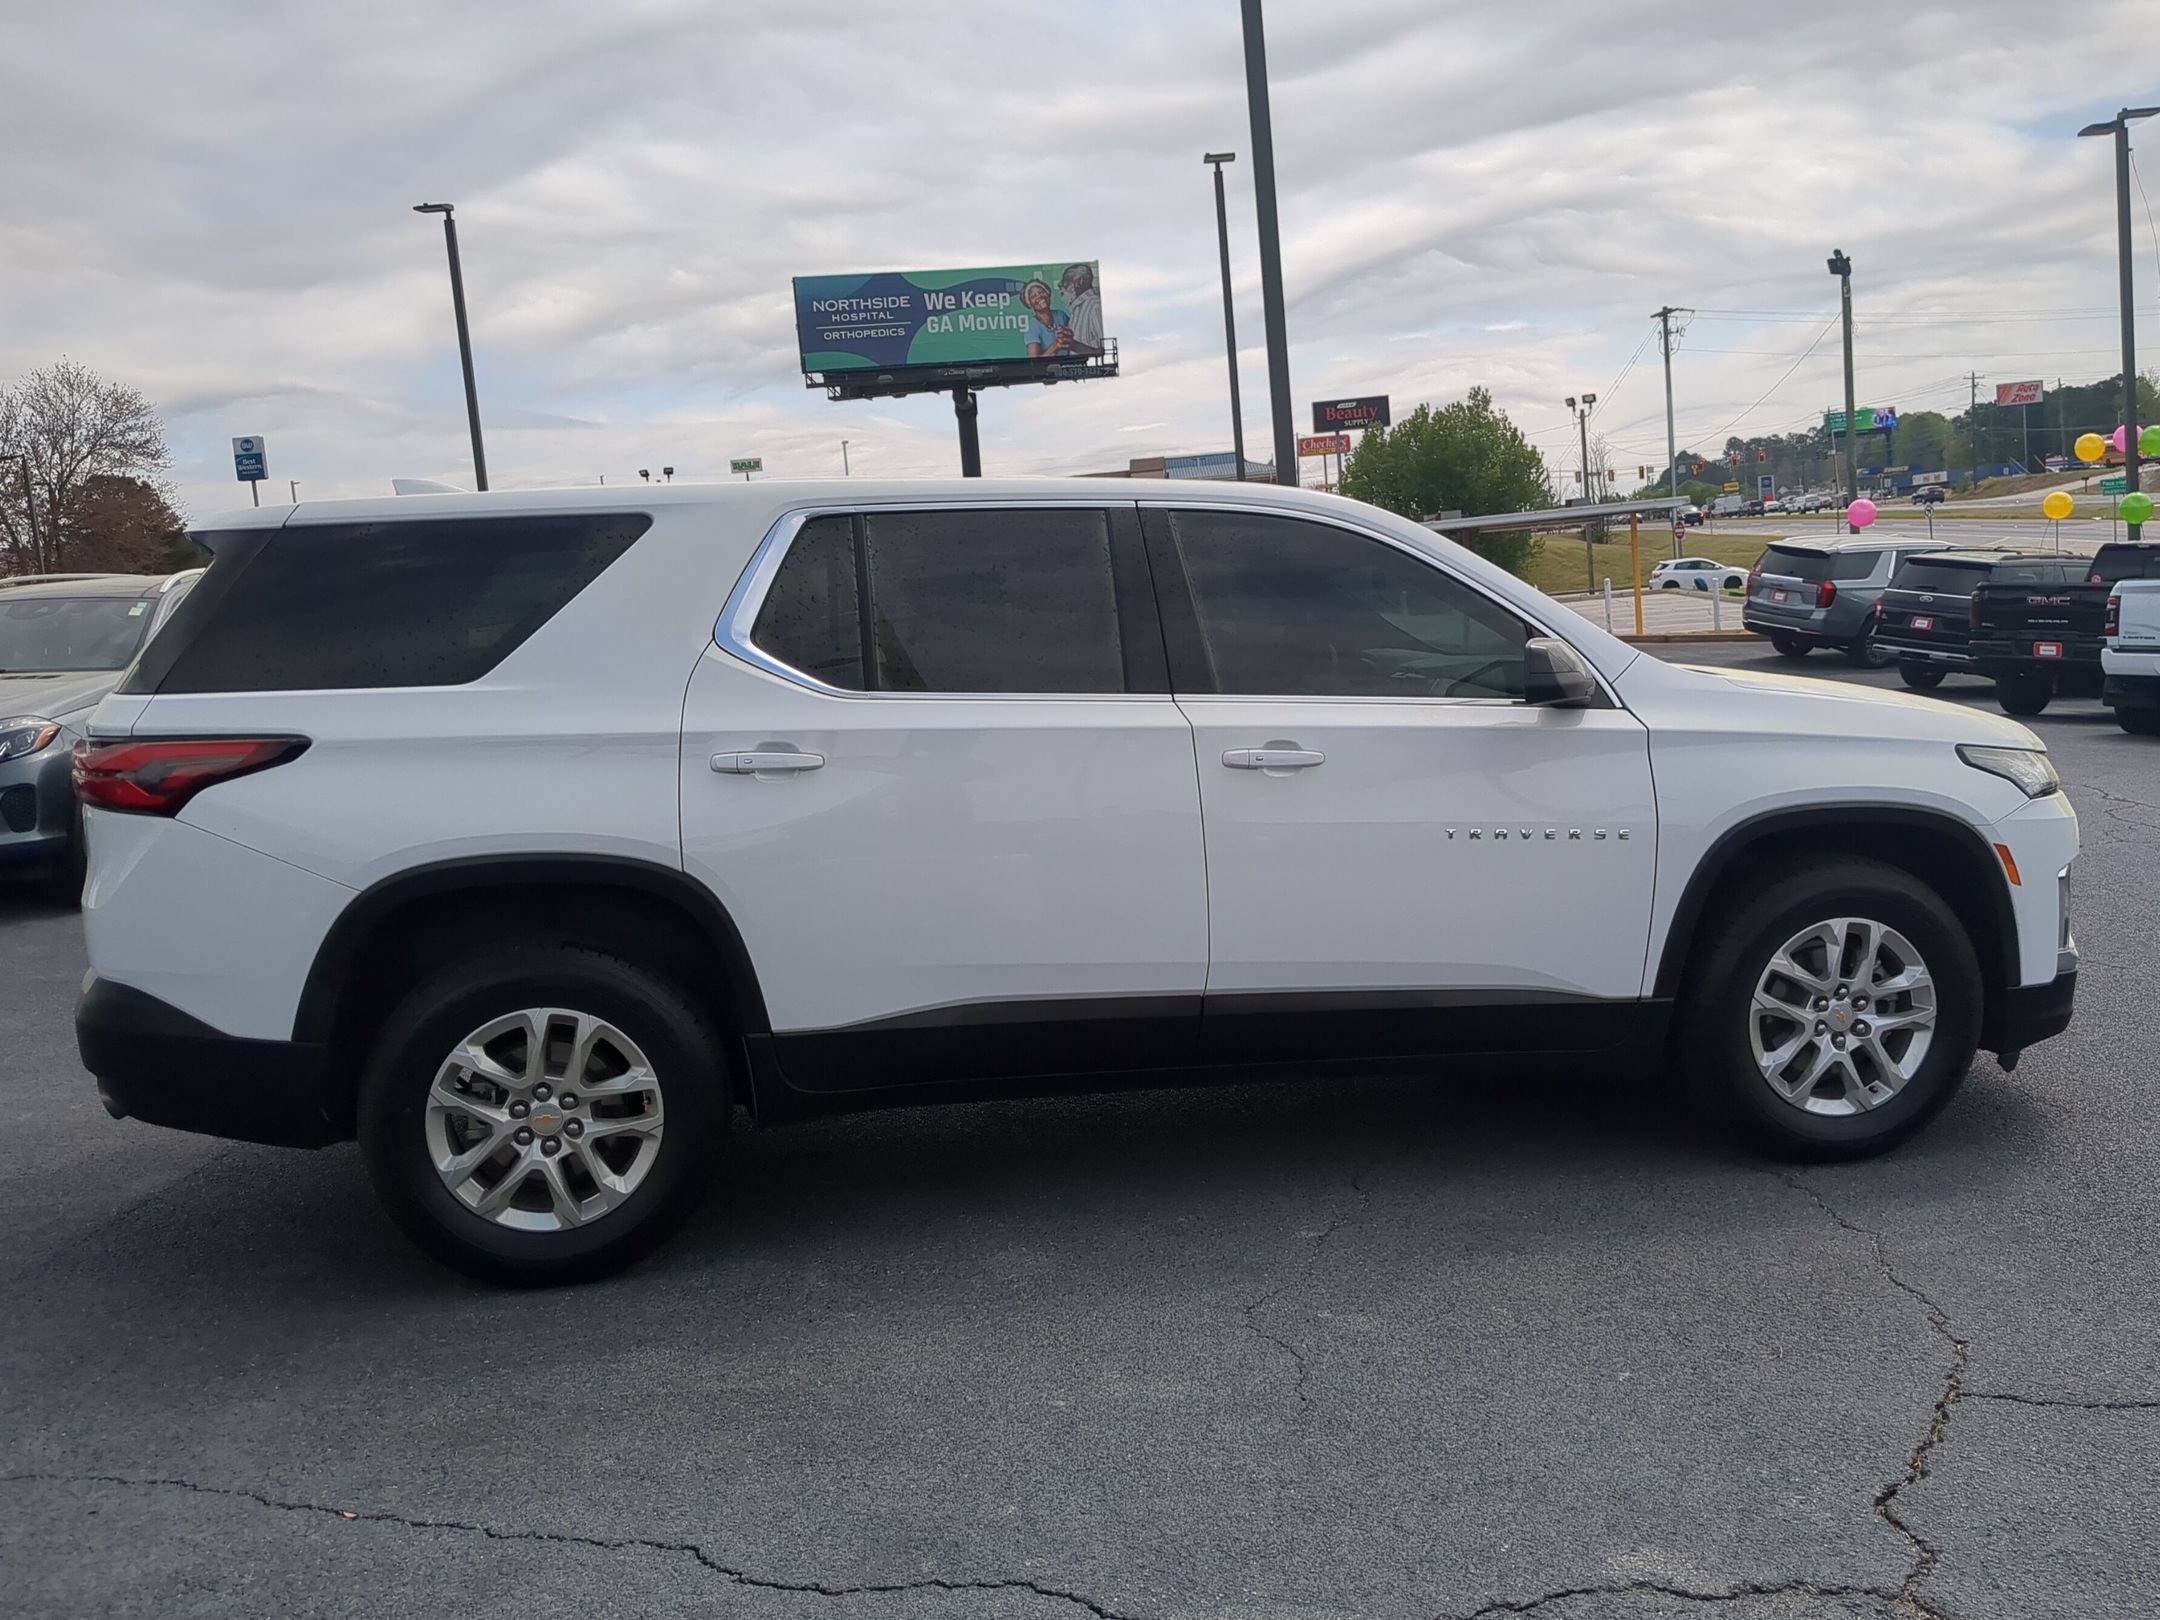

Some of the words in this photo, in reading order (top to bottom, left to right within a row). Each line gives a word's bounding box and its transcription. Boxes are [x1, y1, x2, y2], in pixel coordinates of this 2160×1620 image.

[812, 296, 911, 312] NORTHSIDE
[924, 292, 954, 311] We
[961, 290, 1011, 310] Keep
[832, 311, 895, 322] HOSPITAL
[926, 315, 954, 334] GA
[958, 312, 1030, 333] Moving
[823, 328, 905, 340] ORTHOPEDICS
[1326, 406, 1378, 420] Beauty
[1344, 419, 1368, 427] SUPPLY
[2027, 596, 2071, 606] GMC
[1445, 828, 1631, 840] TRAVERSE
